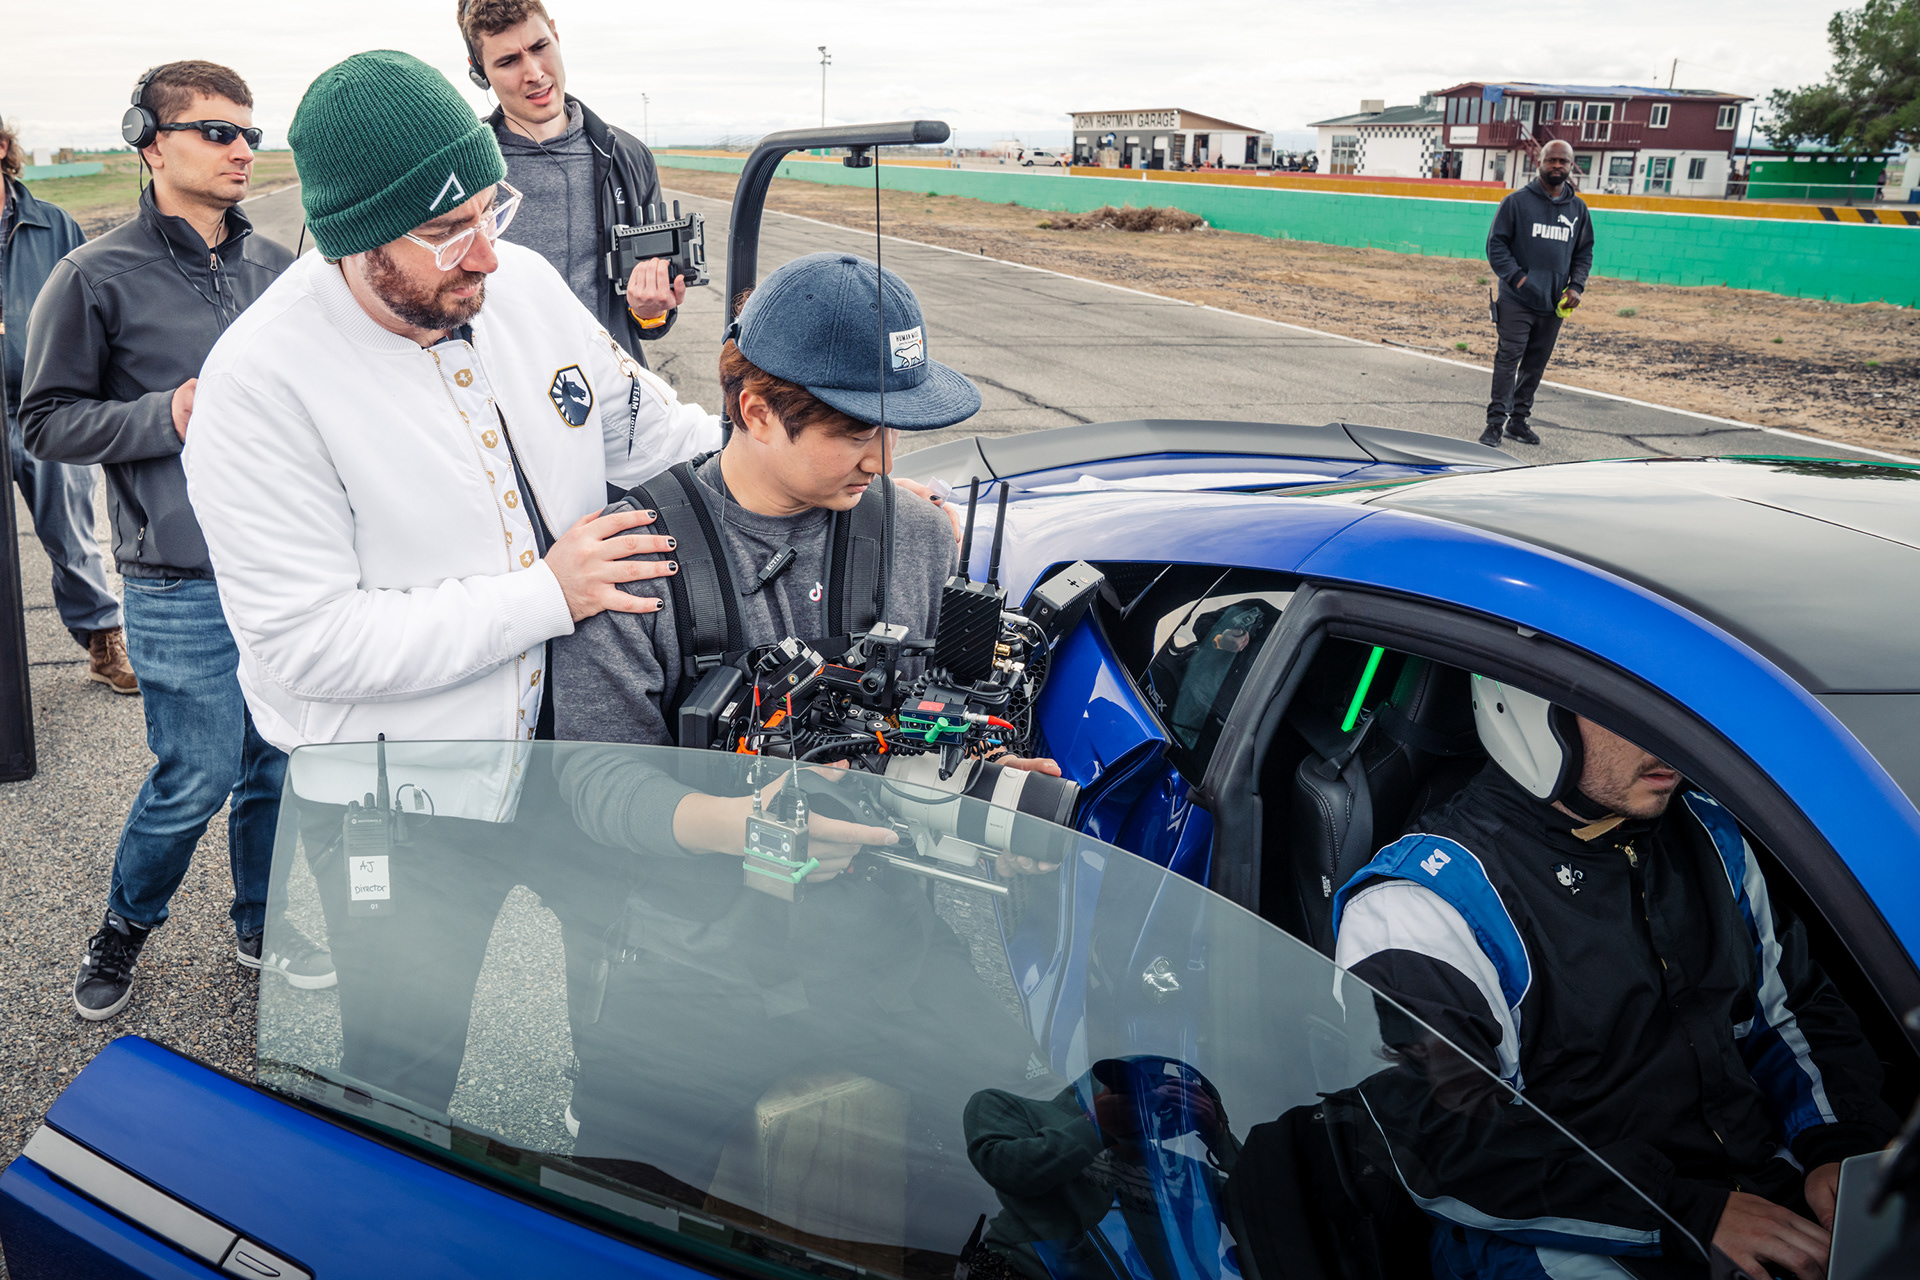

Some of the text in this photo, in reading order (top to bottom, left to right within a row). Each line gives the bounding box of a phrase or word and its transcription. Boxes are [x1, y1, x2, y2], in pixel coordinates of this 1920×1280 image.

[1096, 113, 1134, 128] HARTMAN
[1137, 112, 1175, 127] GARAGE
[1532, 222, 1570, 242] PUMA
[631, 386, 640, 410] TEAM
[1145, 683, 1167, 713] NSX
[360, 860, 374, 873] AJ
[1420, 848, 1451, 877] K1
